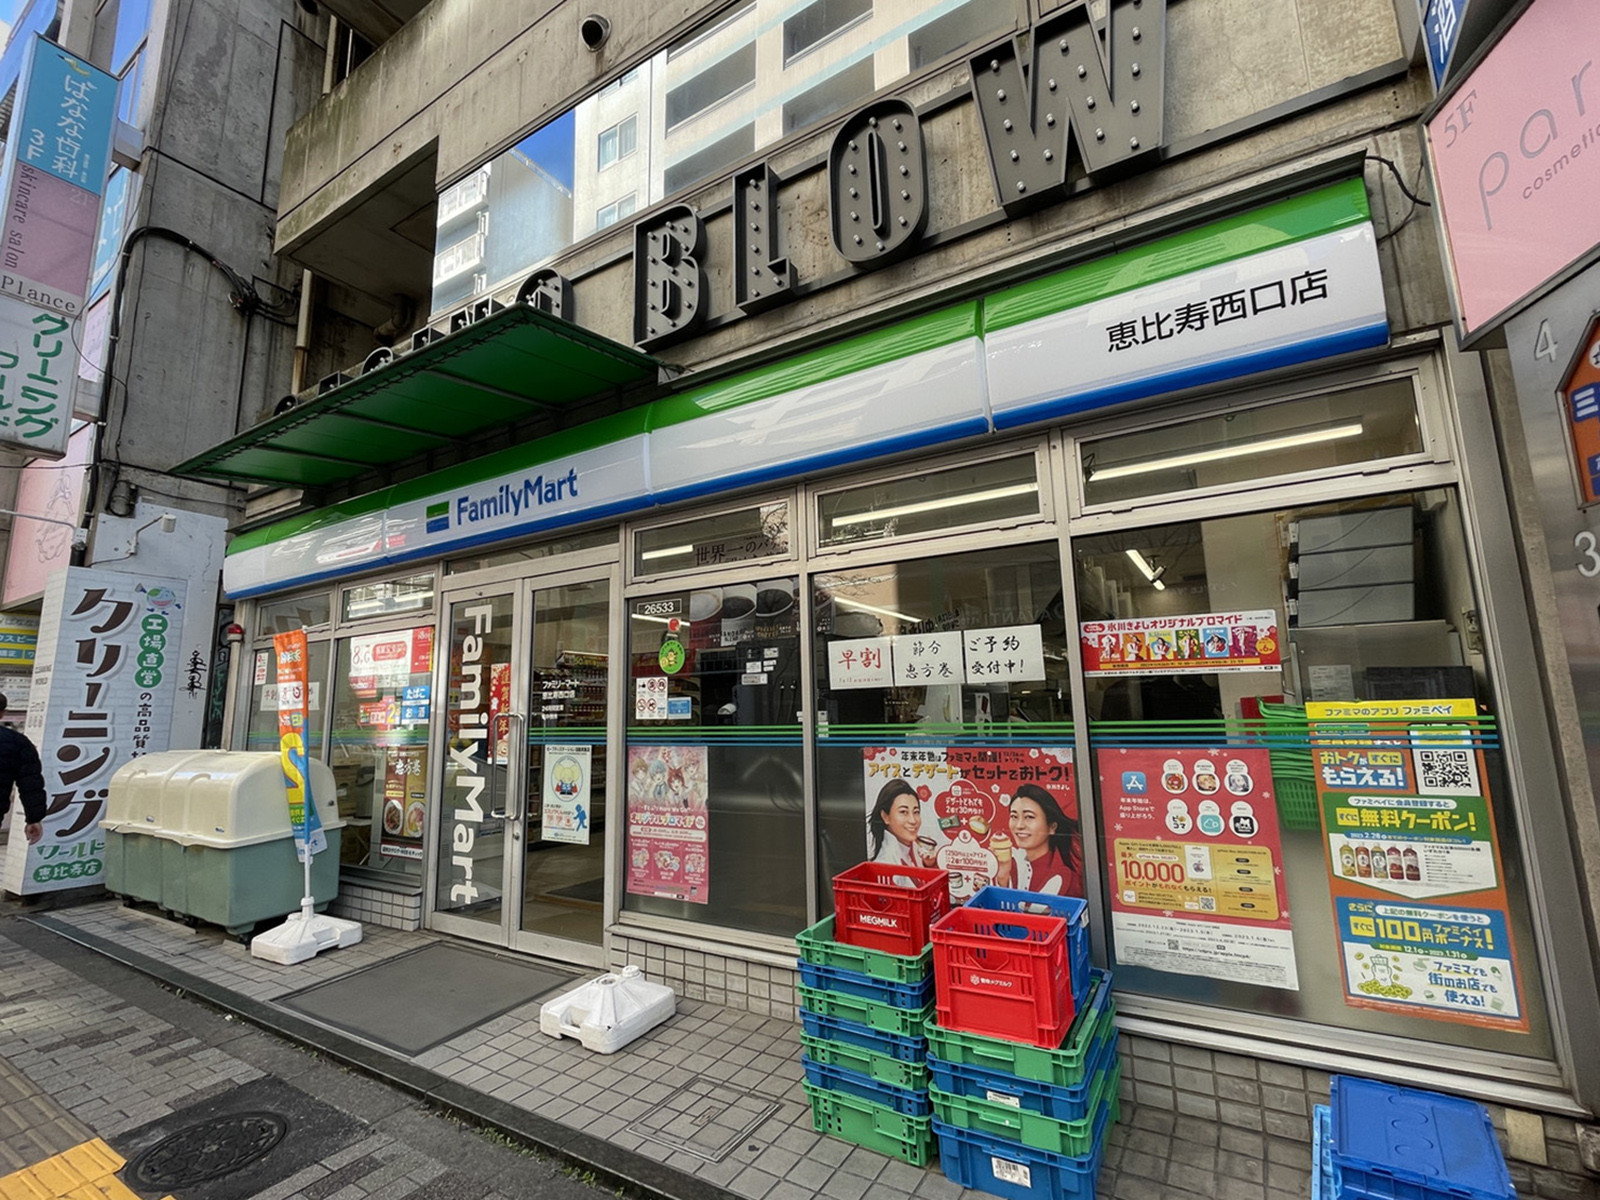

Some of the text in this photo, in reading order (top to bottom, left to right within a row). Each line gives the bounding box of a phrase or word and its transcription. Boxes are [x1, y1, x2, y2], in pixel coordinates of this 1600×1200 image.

[51, 74, 97, 179] ばなな歯科
[1443, 89, 1477, 149] 5F
[27, 129, 44, 159] 3F
[633, 0, 1166, 352] BLOW
[5, 165, 38, 269] skincare salon
[0, 275, 76, 312] Plance
[1106, 268, 1328, 352] 恵比寿西口店
[1534, 318, 1559, 362] 4
[15, 314, 69, 438] クリーニング
[457, 467, 578, 525] FamilyMart
[1574, 531, 1600, 577] 3
[644, 602, 674, 614] 26533
[912, 639, 942, 656] 節分
[969, 636, 1021, 653] ご予約
[838, 647, 882, 670] 早割
[971, 659, 1025, 676] 受付中!
[905, 662, 953, 679] 恵方巻
[131, 617, 166, 758] 工場直営の高品質
[406, 687, 426, 699] たばこ
[542, 679, 580, 689] ファミリーマート
[45, 588, 134, 838] クリーニング
[1324, 705, 1453, 716] ファミマのアプリ ファミペイ
[450, 603, 493, 905] FamilyMart
[868, 763, 1070, 782] アイスとデザートがセットでおトク!
[1322, 765, 1404, 787] もらえる!
[1354, 798, 1450, 808] ファミペイに会員登録すると
[36, 840, 106, 861] ワールド
[37, 861, 100, 881] 恵比寿店
[1121, 860, 1185, 883] 10,000
[1124, 880, 1212, 893] ポイントがもれなくもらえる!
[860, 914, 898, 928] MEGMILK
[1348, 903, 1485, 923] さらに 上記の無料クーポンを使うと
[1433, 923, 1482, 936] ファミペイ
[1435, 933, 1484, 948] ボーナス
[1433, 961, 1488, 977] ファミマでも
[1427, 972, 1498, 993] 街のお店でも
[1444, 989, 1486, 1007] 使える!
